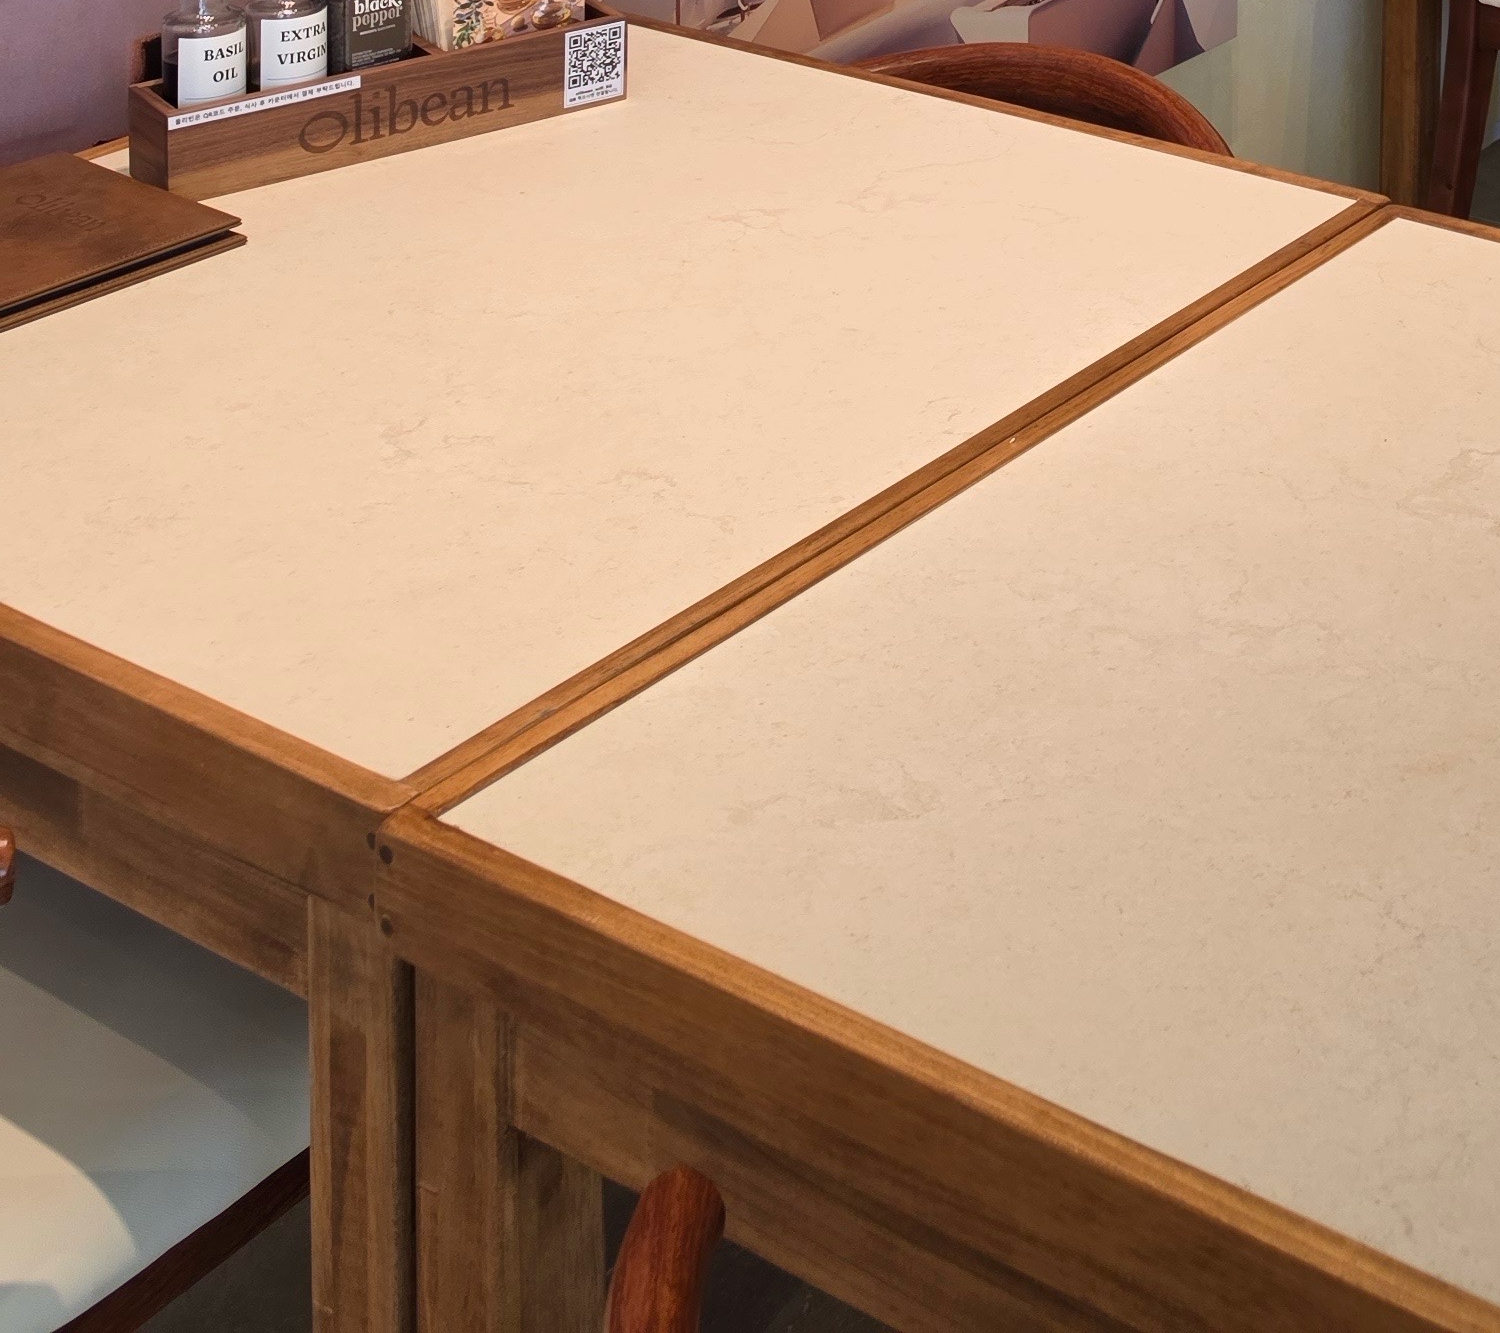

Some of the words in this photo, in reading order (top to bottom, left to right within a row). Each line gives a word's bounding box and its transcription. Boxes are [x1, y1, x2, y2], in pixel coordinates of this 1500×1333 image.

[280, 21, 326, 43] EXTRA
[203, 40, 244, 62] BASIL
[277, 43, 327, 66] VIRGIN
[212, 67, 239, 83] OIL
[298, 77, 516, 154] Olibean
